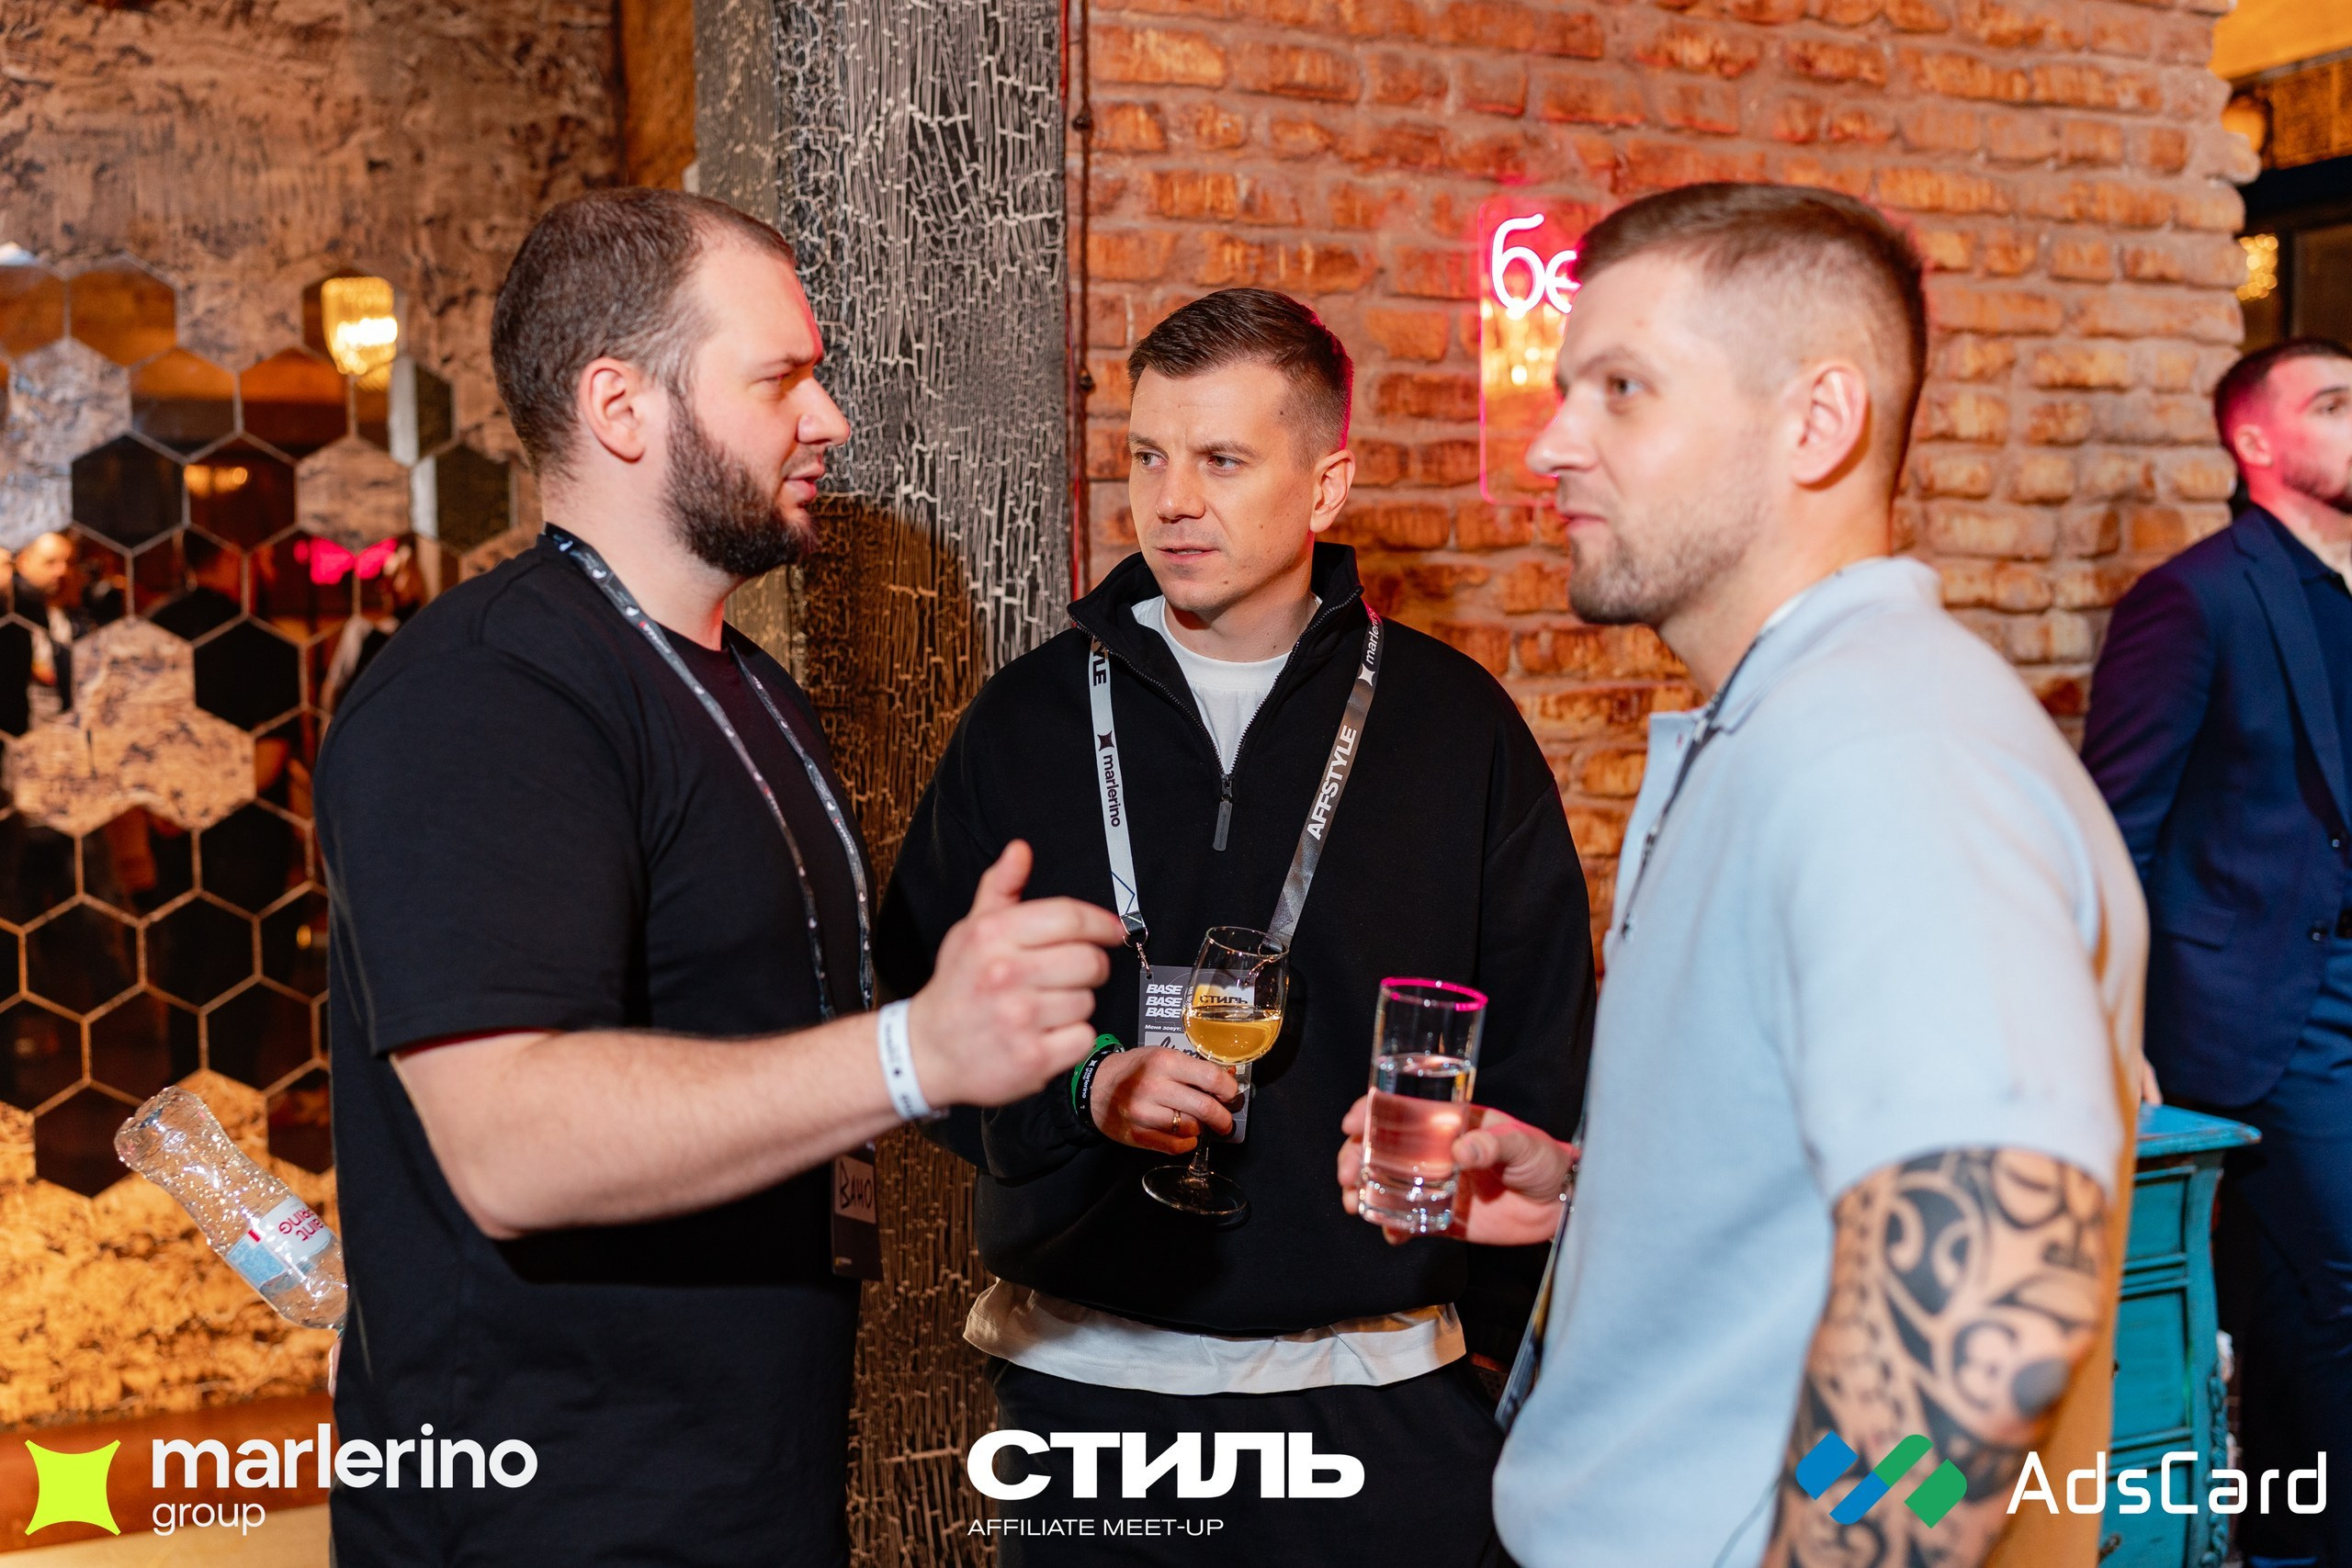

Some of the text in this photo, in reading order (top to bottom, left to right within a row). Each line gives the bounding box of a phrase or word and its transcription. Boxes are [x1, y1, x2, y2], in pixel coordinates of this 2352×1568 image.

[1306, 725, 1357, 840] AFFSTYLE
[1103, 754, 1121, 828] marlerino
[1146, 984, 1183, 995] BASE
[1145, 996, 1183, 1008] BASE
[1145, 1007, 1182, 1019] BASE
